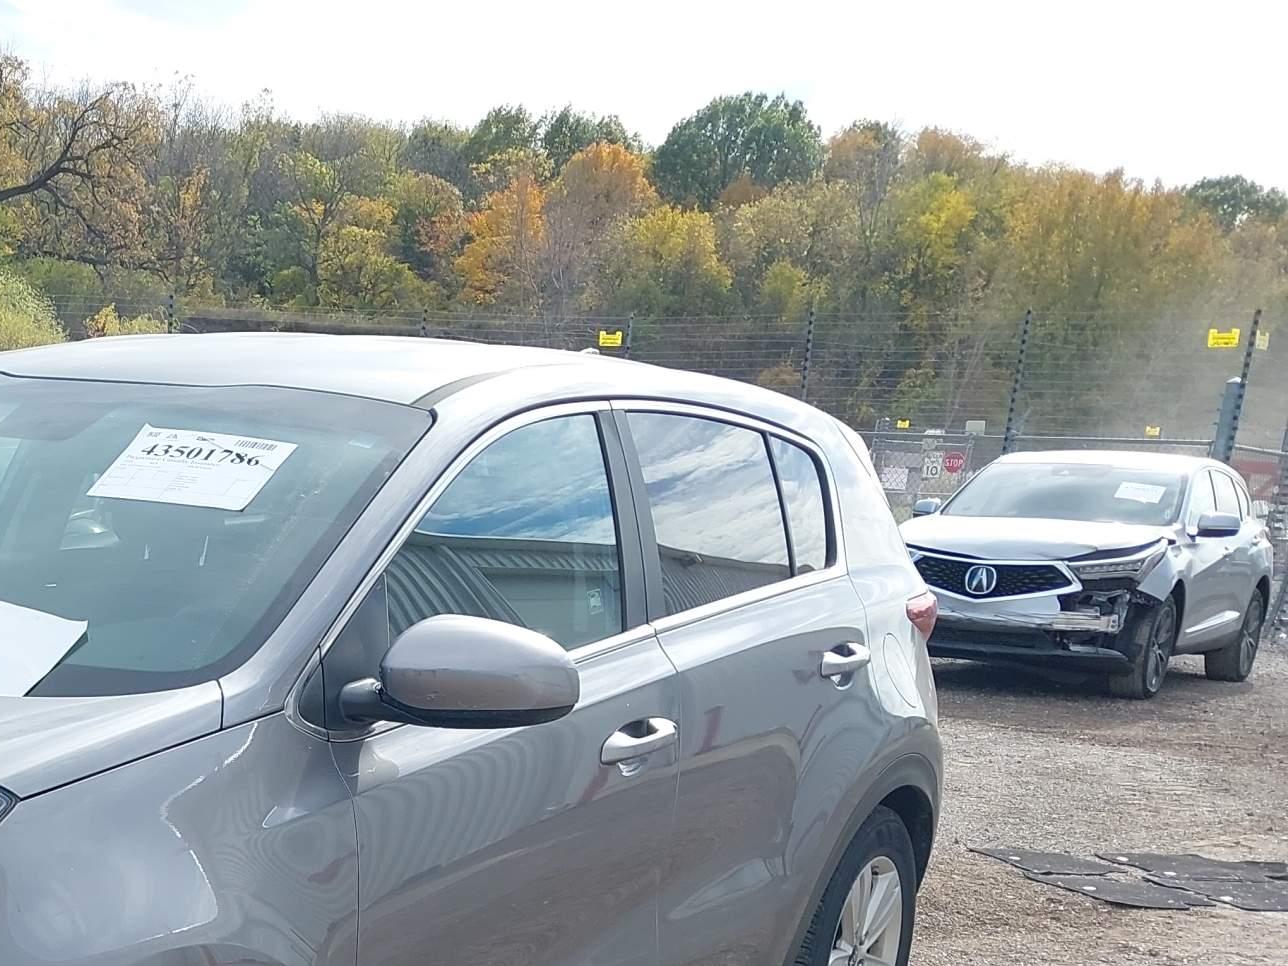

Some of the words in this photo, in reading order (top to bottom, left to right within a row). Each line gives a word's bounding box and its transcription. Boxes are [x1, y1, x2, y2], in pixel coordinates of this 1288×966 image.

[141, 442, 263, 467] 43501786
[945, 458, 964, 468] STOP
[926, 465, 938, 476] 10
